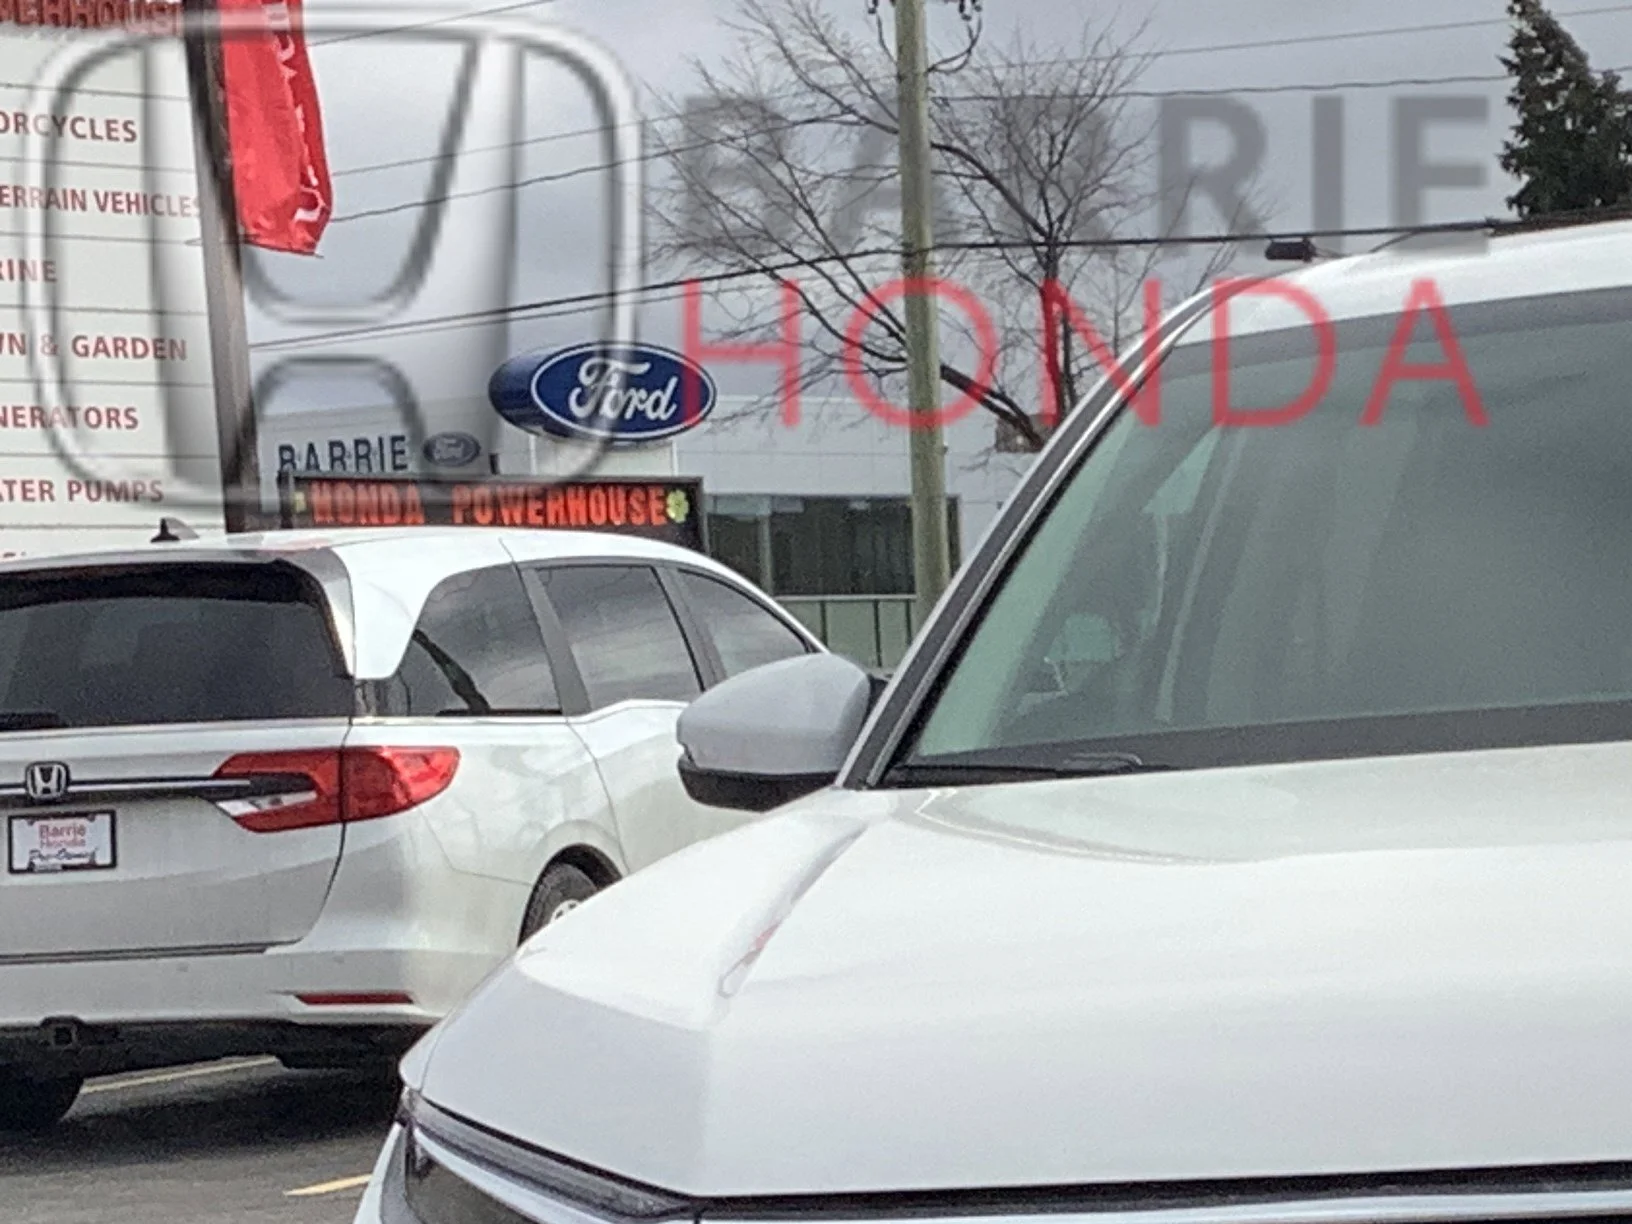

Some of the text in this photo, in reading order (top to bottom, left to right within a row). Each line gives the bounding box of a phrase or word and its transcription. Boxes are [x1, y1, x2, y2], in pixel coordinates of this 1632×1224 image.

[0, 0, 183, 35] ERHOUS
[0, 258, 58, 283] INE
[0, 332, 27, 356] N
[71, 335, 188, 362] GARDEN
[569, 356, 679, 422] Ford
[278, 435, 408, 472] BARRIE
[0, 478, 165, 502] TER PUMPS
[310, 481, 667, 526] HONDA POWERHOUSE
